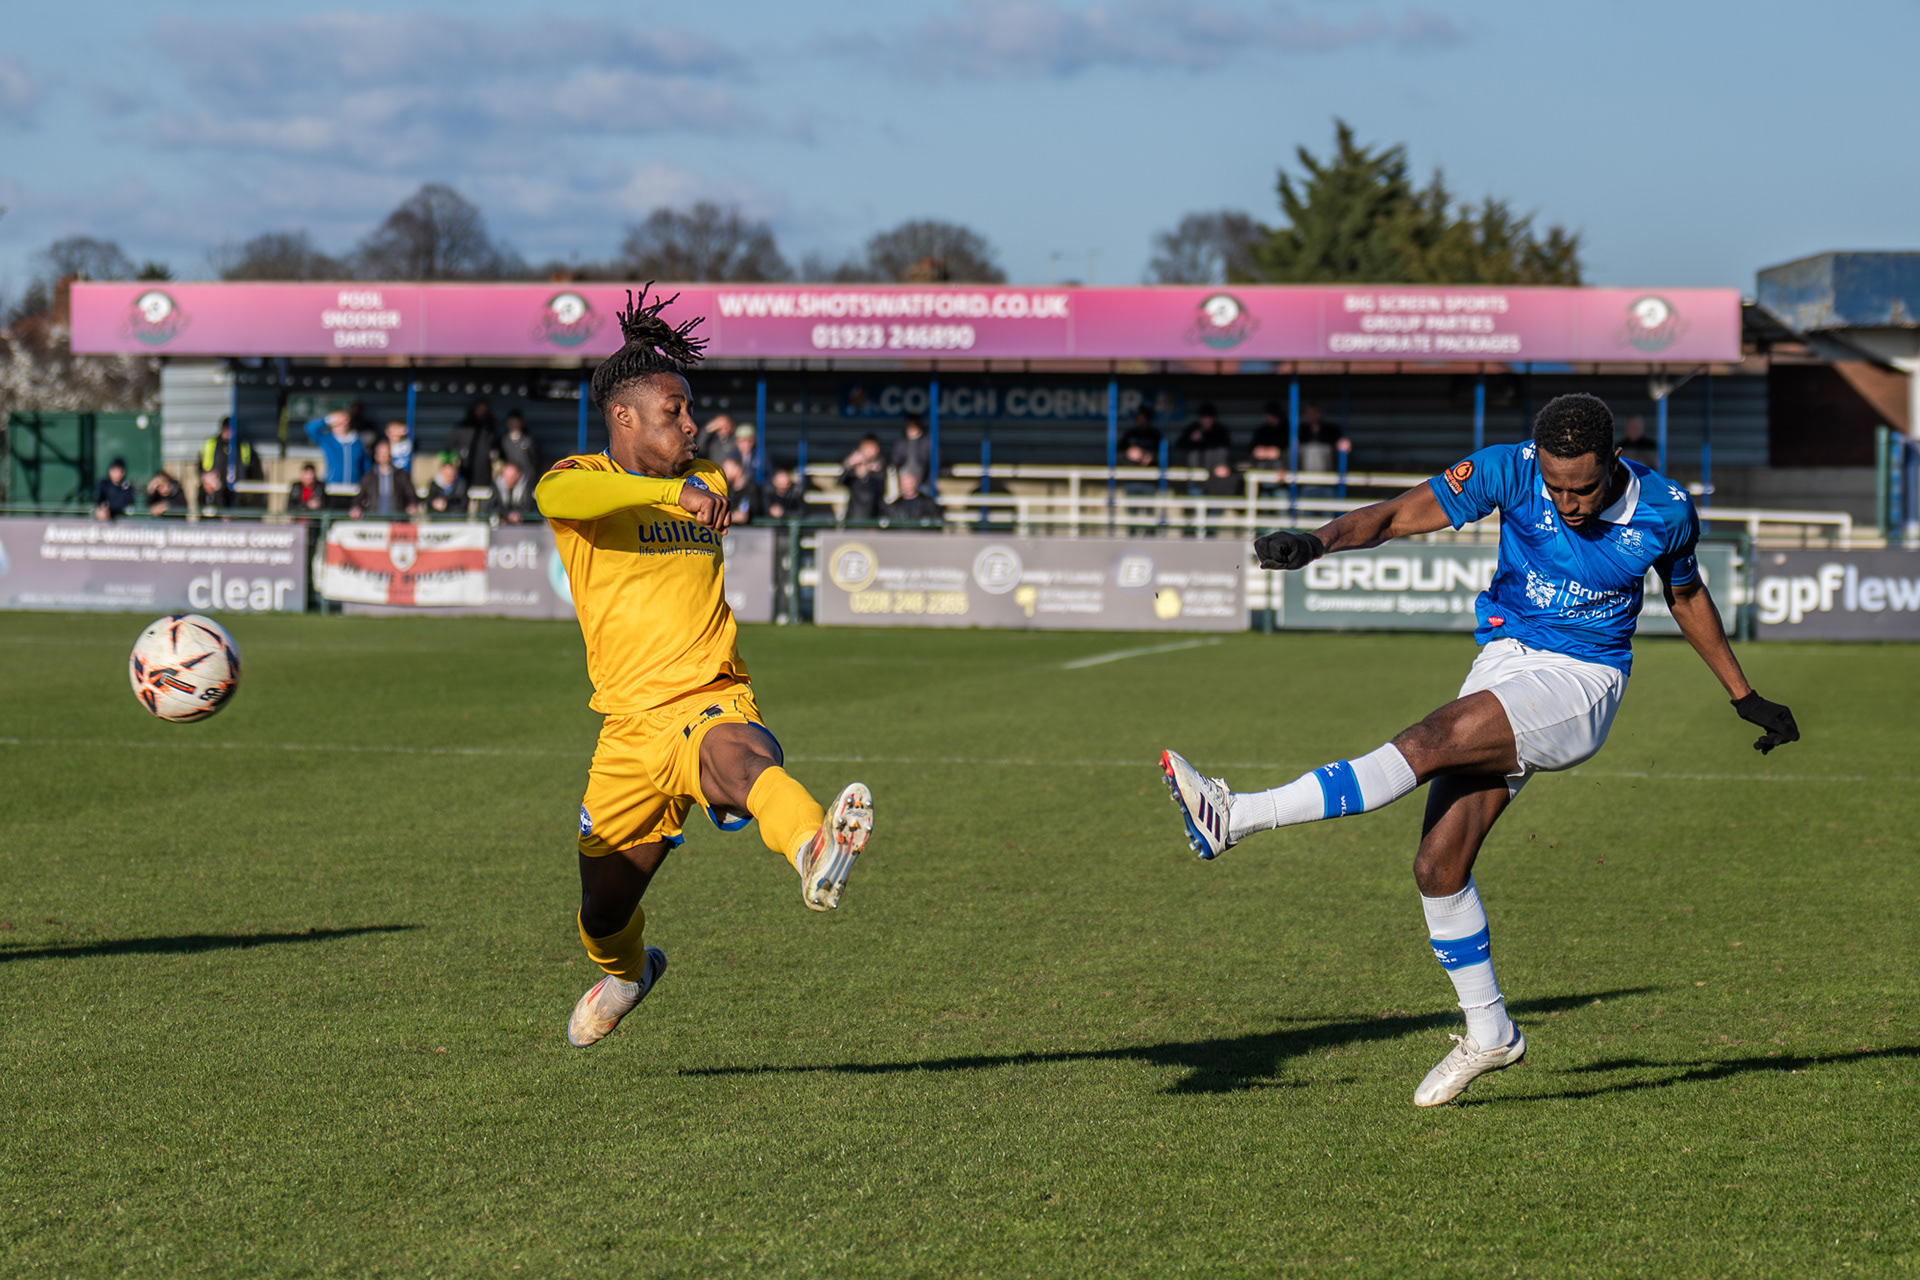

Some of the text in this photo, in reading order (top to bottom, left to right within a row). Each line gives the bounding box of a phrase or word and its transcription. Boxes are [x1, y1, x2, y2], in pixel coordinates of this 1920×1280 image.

[338, 291, 383, 310] POOL
[718, 293, 1068, 318] WWW.SHOTSWATFORD.CO.UK
[1344, 295, 1509, 314] BIG SCREEN SPORTS
[321, 309, 401, 330] SNOOKER
[1361, 314, 1495, 334] GROUP PARTIES
[334, 329, 389, 349] DARTS
[812, 323, 885, 349] 01923
[1329, 333, 1521, 354] CORPORATE PACKAGES
[44, 524, 294, 550] Award-winning insurance cover
[639, 546, 715, 557] life with power
[187, 568, 297, 611] clear
[1305, 594, 1394, 612] Commercial
[1397, 595, 1449, 615] Sports
